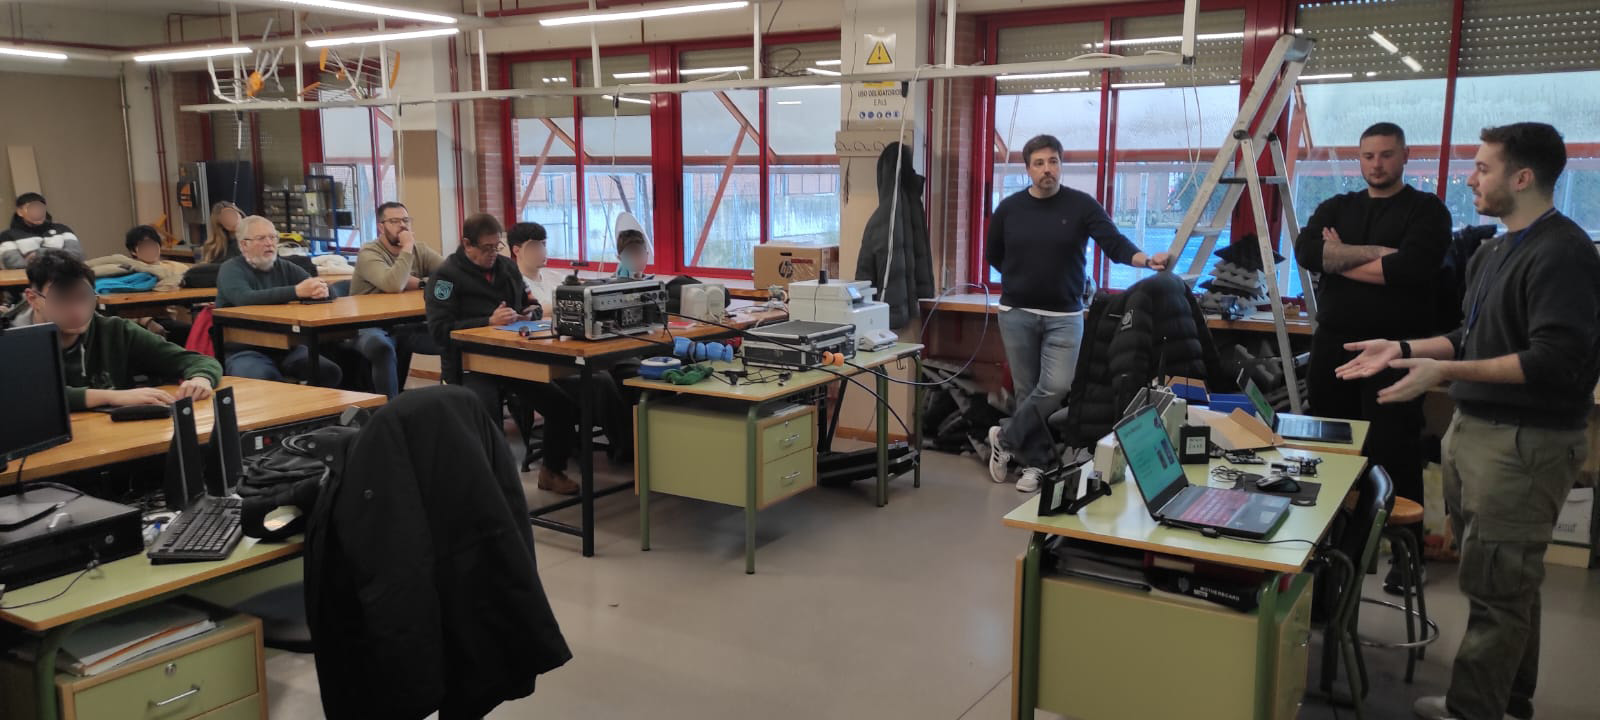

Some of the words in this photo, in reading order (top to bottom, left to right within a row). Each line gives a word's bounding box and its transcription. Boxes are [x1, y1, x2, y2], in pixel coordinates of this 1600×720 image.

[857, 88, 868, 97] USO
[779, 260, 794, 279] hp
[1199, 586, 1240, 601] MOTHERBOARD
